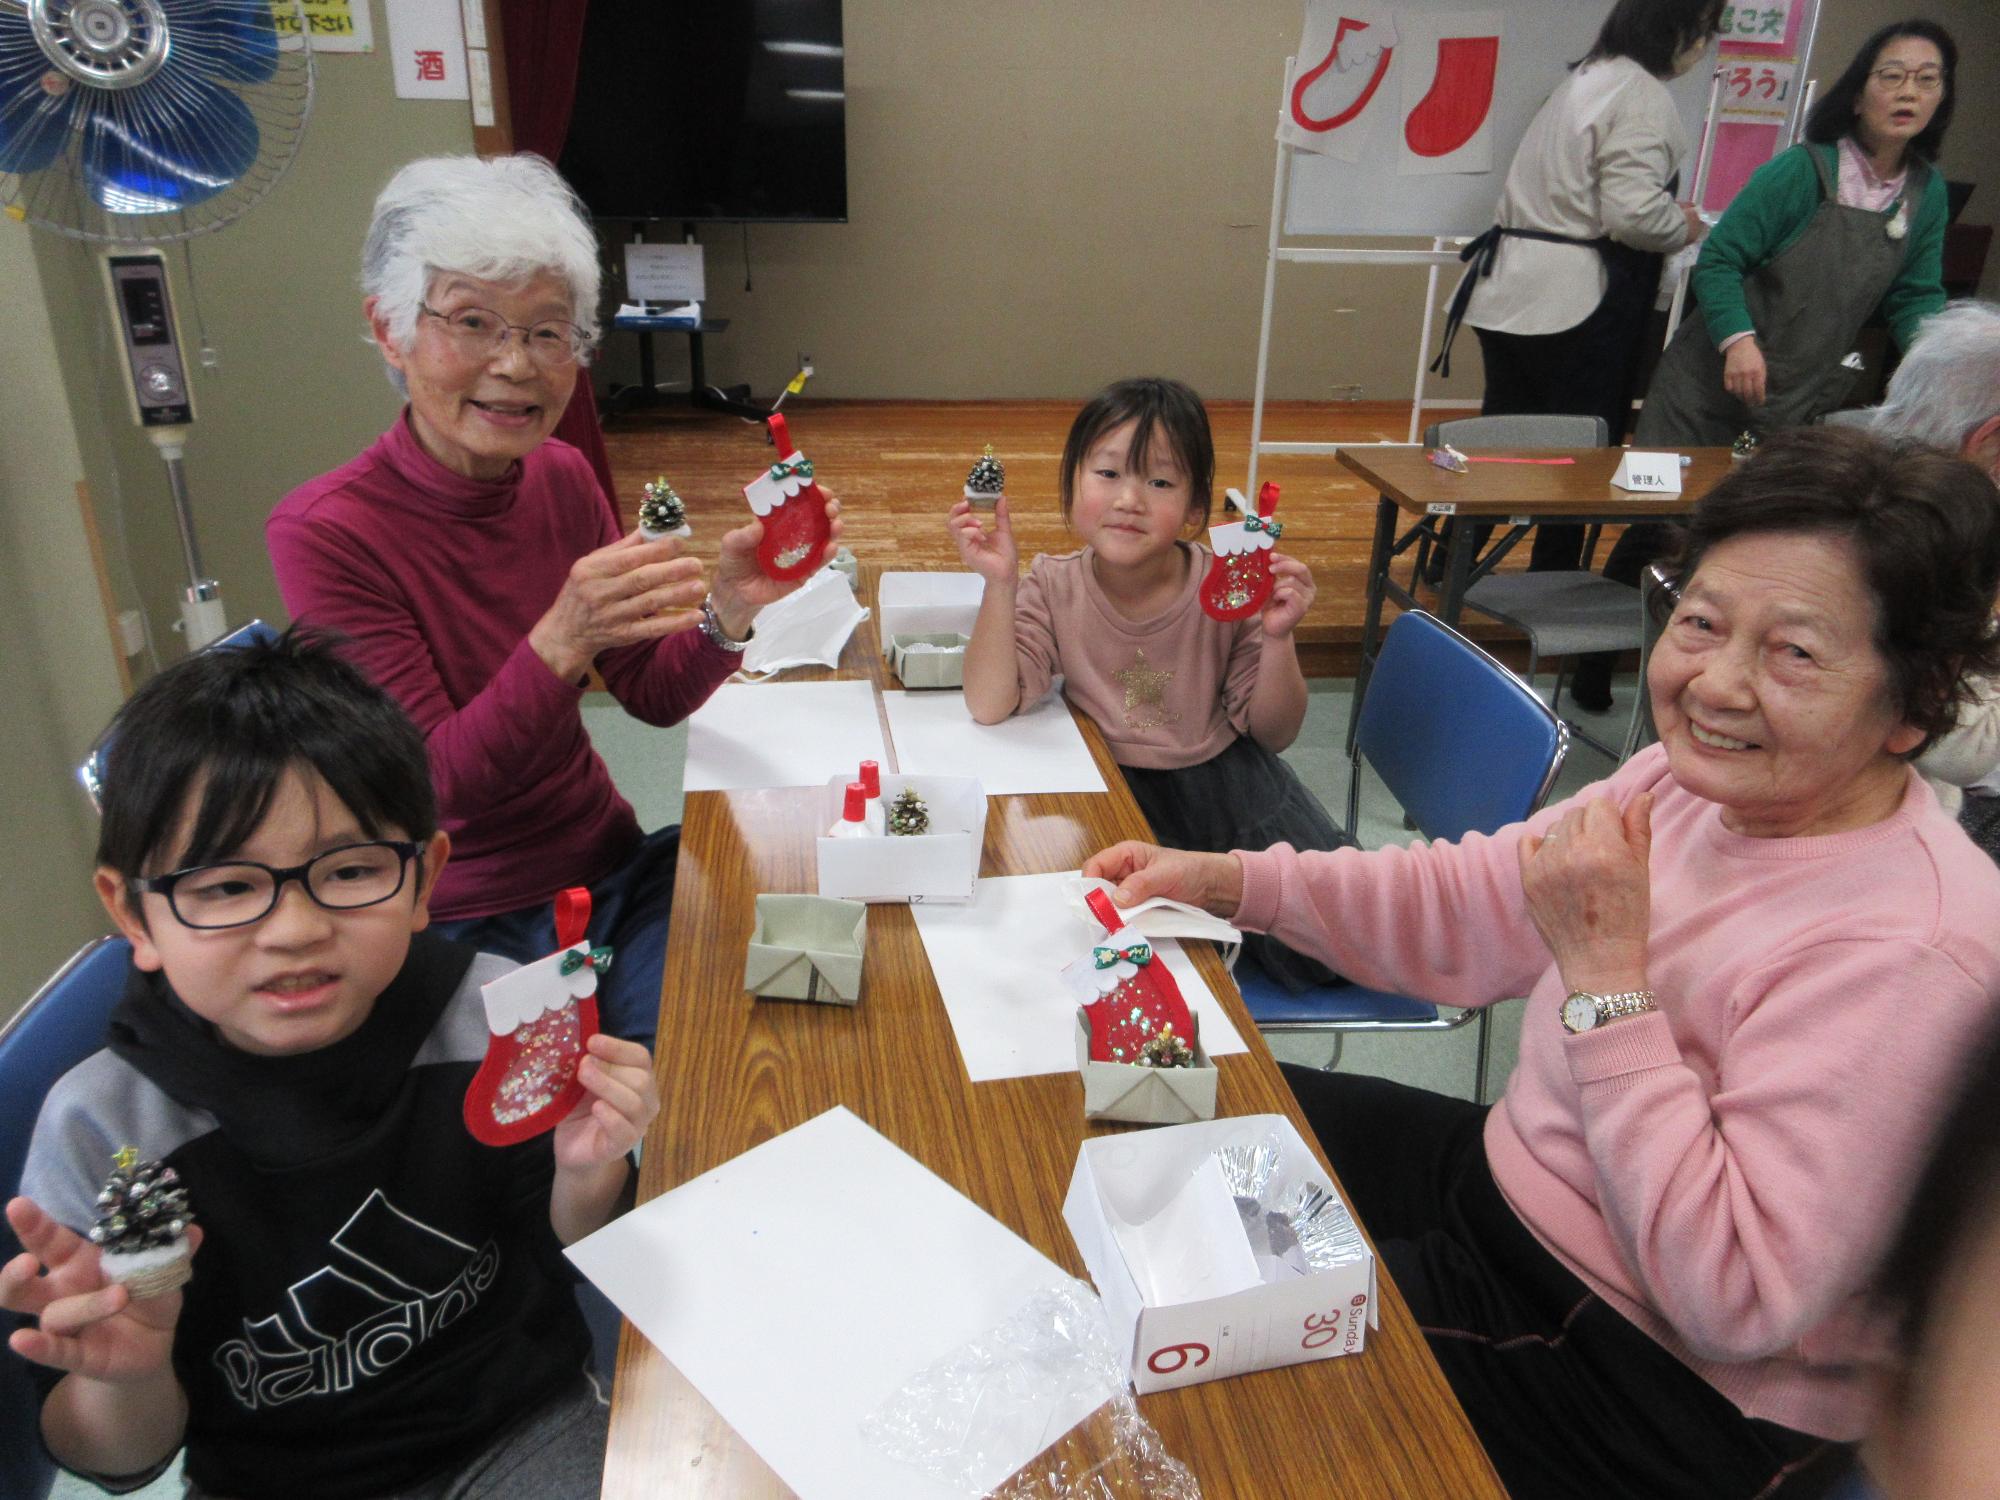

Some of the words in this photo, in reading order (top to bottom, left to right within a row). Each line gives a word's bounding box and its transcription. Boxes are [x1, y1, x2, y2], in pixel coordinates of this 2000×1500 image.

[414, 50, 445, 81] 酒
[1632, 473, 1665, 486] 管理人
[213, 1238, 499, 1410] adidas
[1301, 1308, 1341, 1350] 30
[1345, 1307, 1363, 1354] Sunday
[1147, 1342, 1211, 1374] 6
